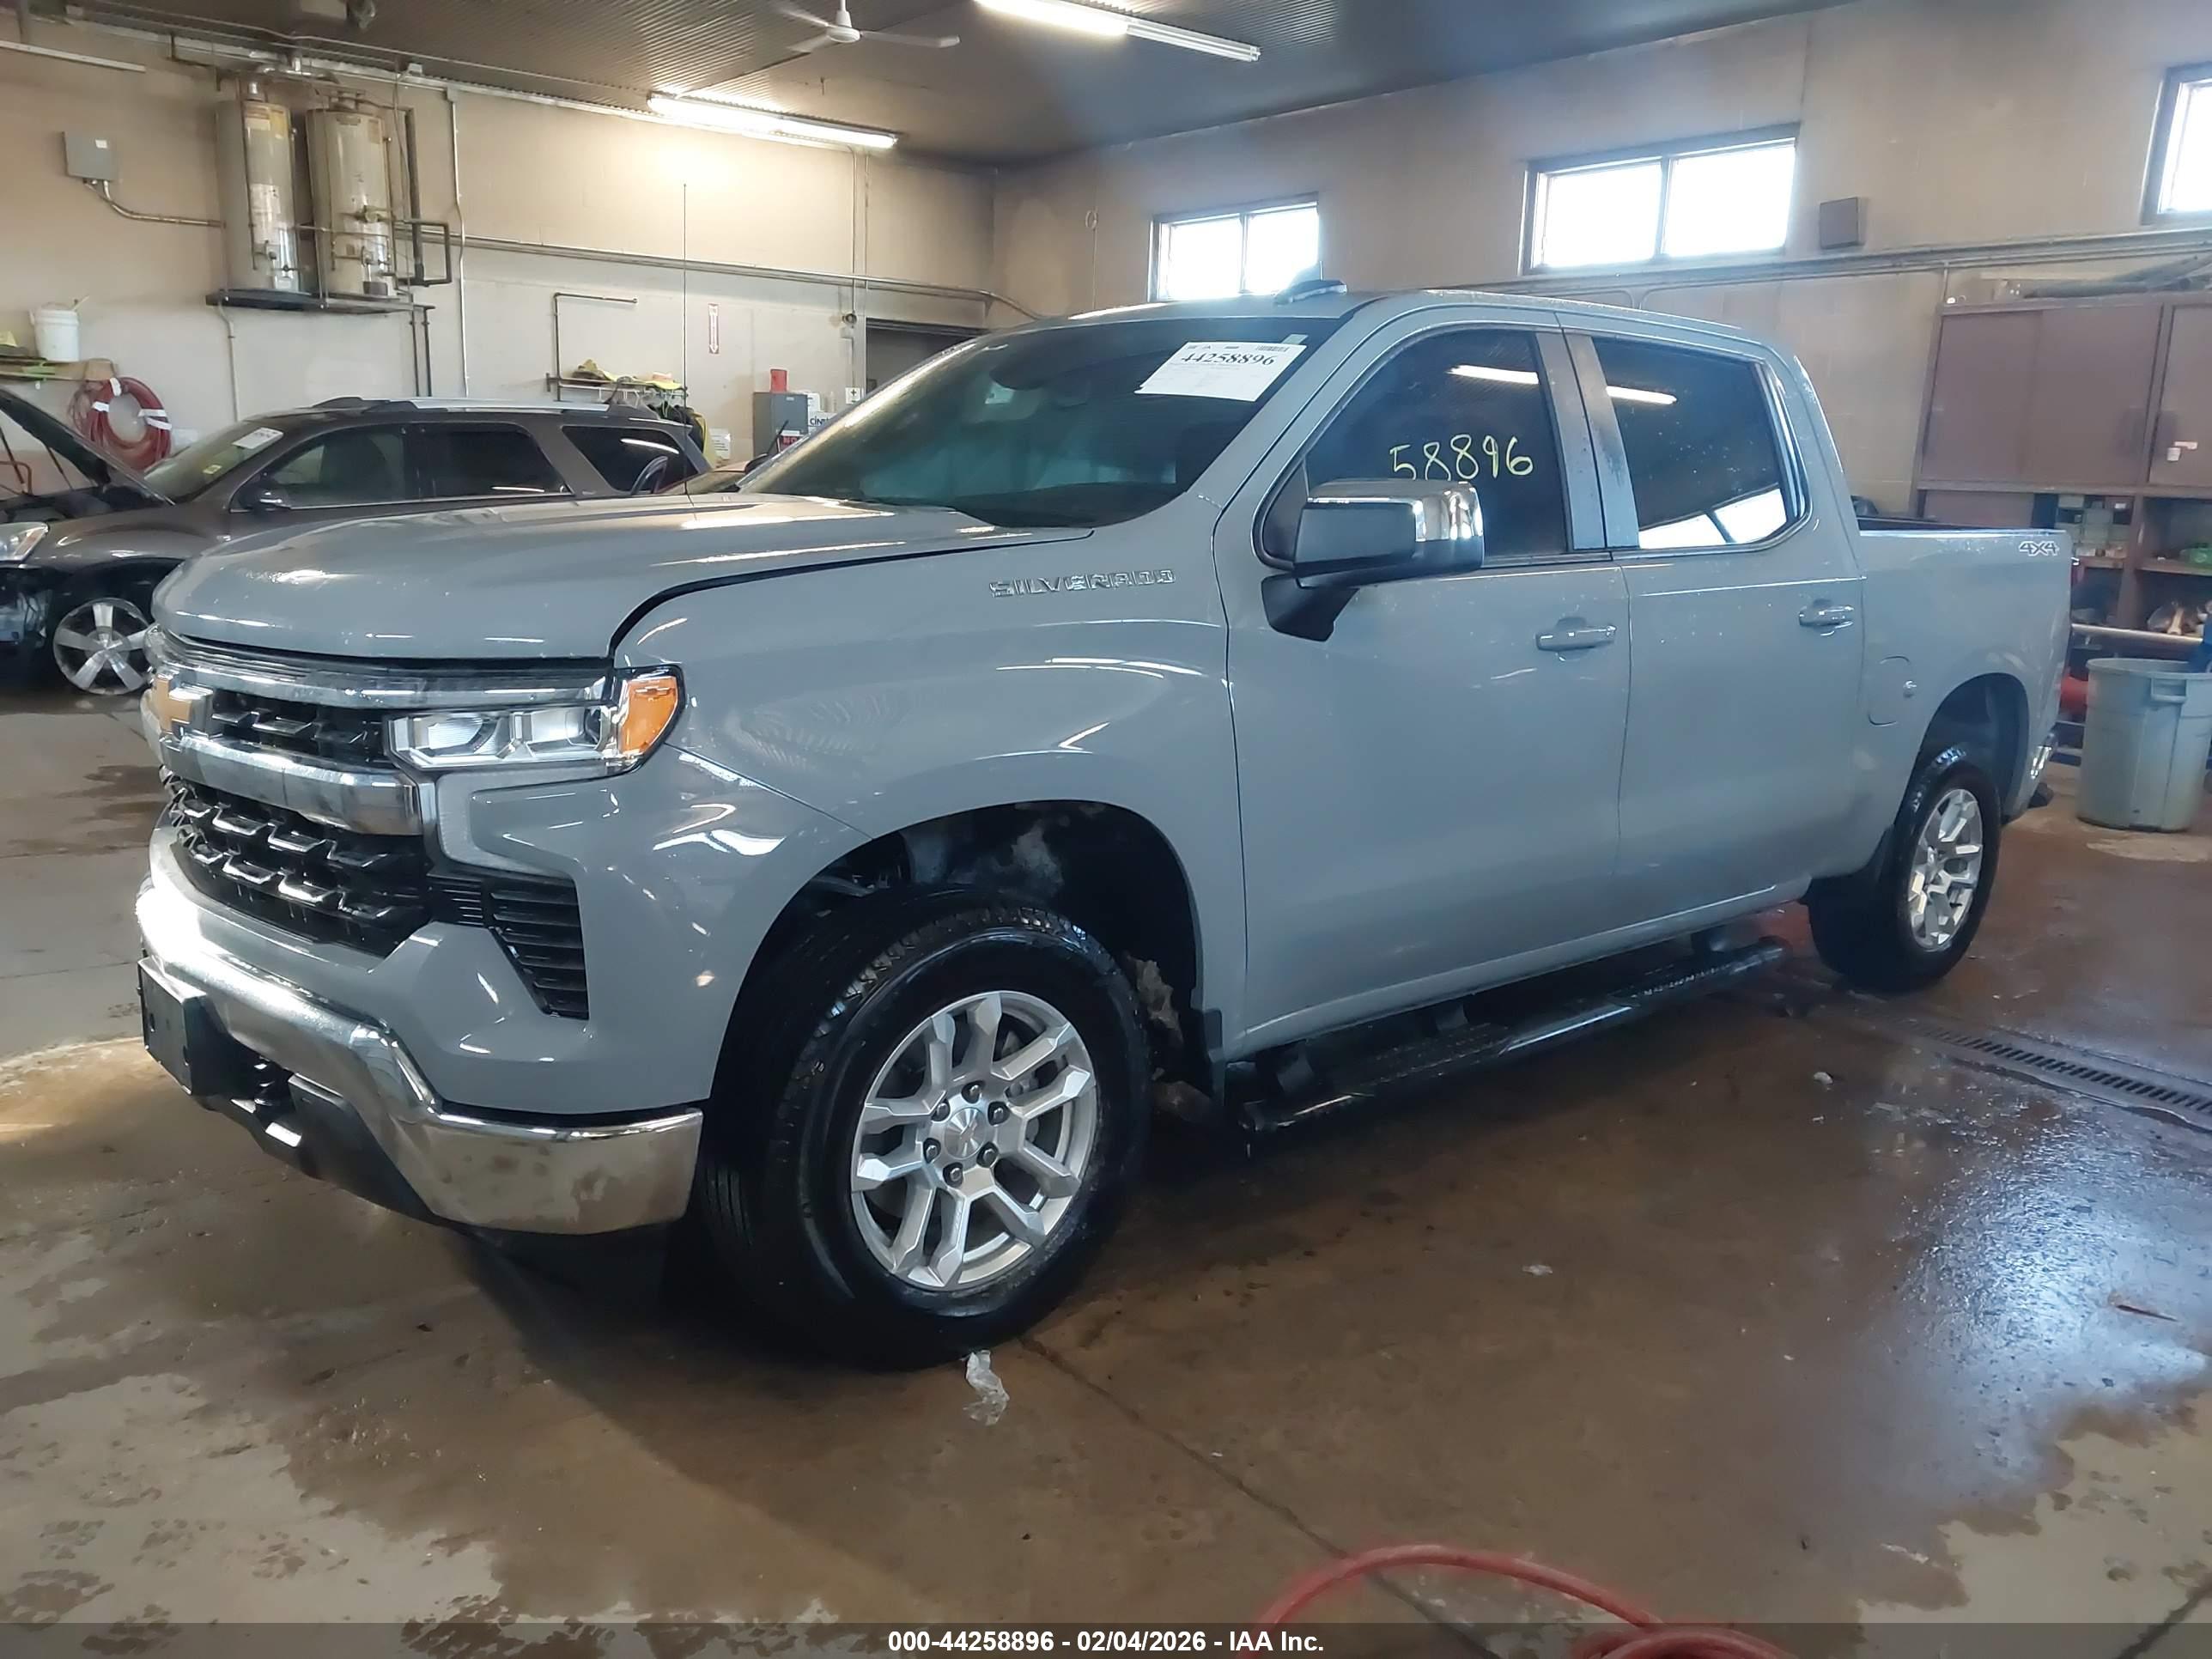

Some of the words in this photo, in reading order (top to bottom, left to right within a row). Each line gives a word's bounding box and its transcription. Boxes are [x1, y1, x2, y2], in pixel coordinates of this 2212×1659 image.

[1182, 353, 1275, 367] 44258896
[1389, 434, 1534, 481] 58896
[989, 568, 1176, 598] SILVERADO
